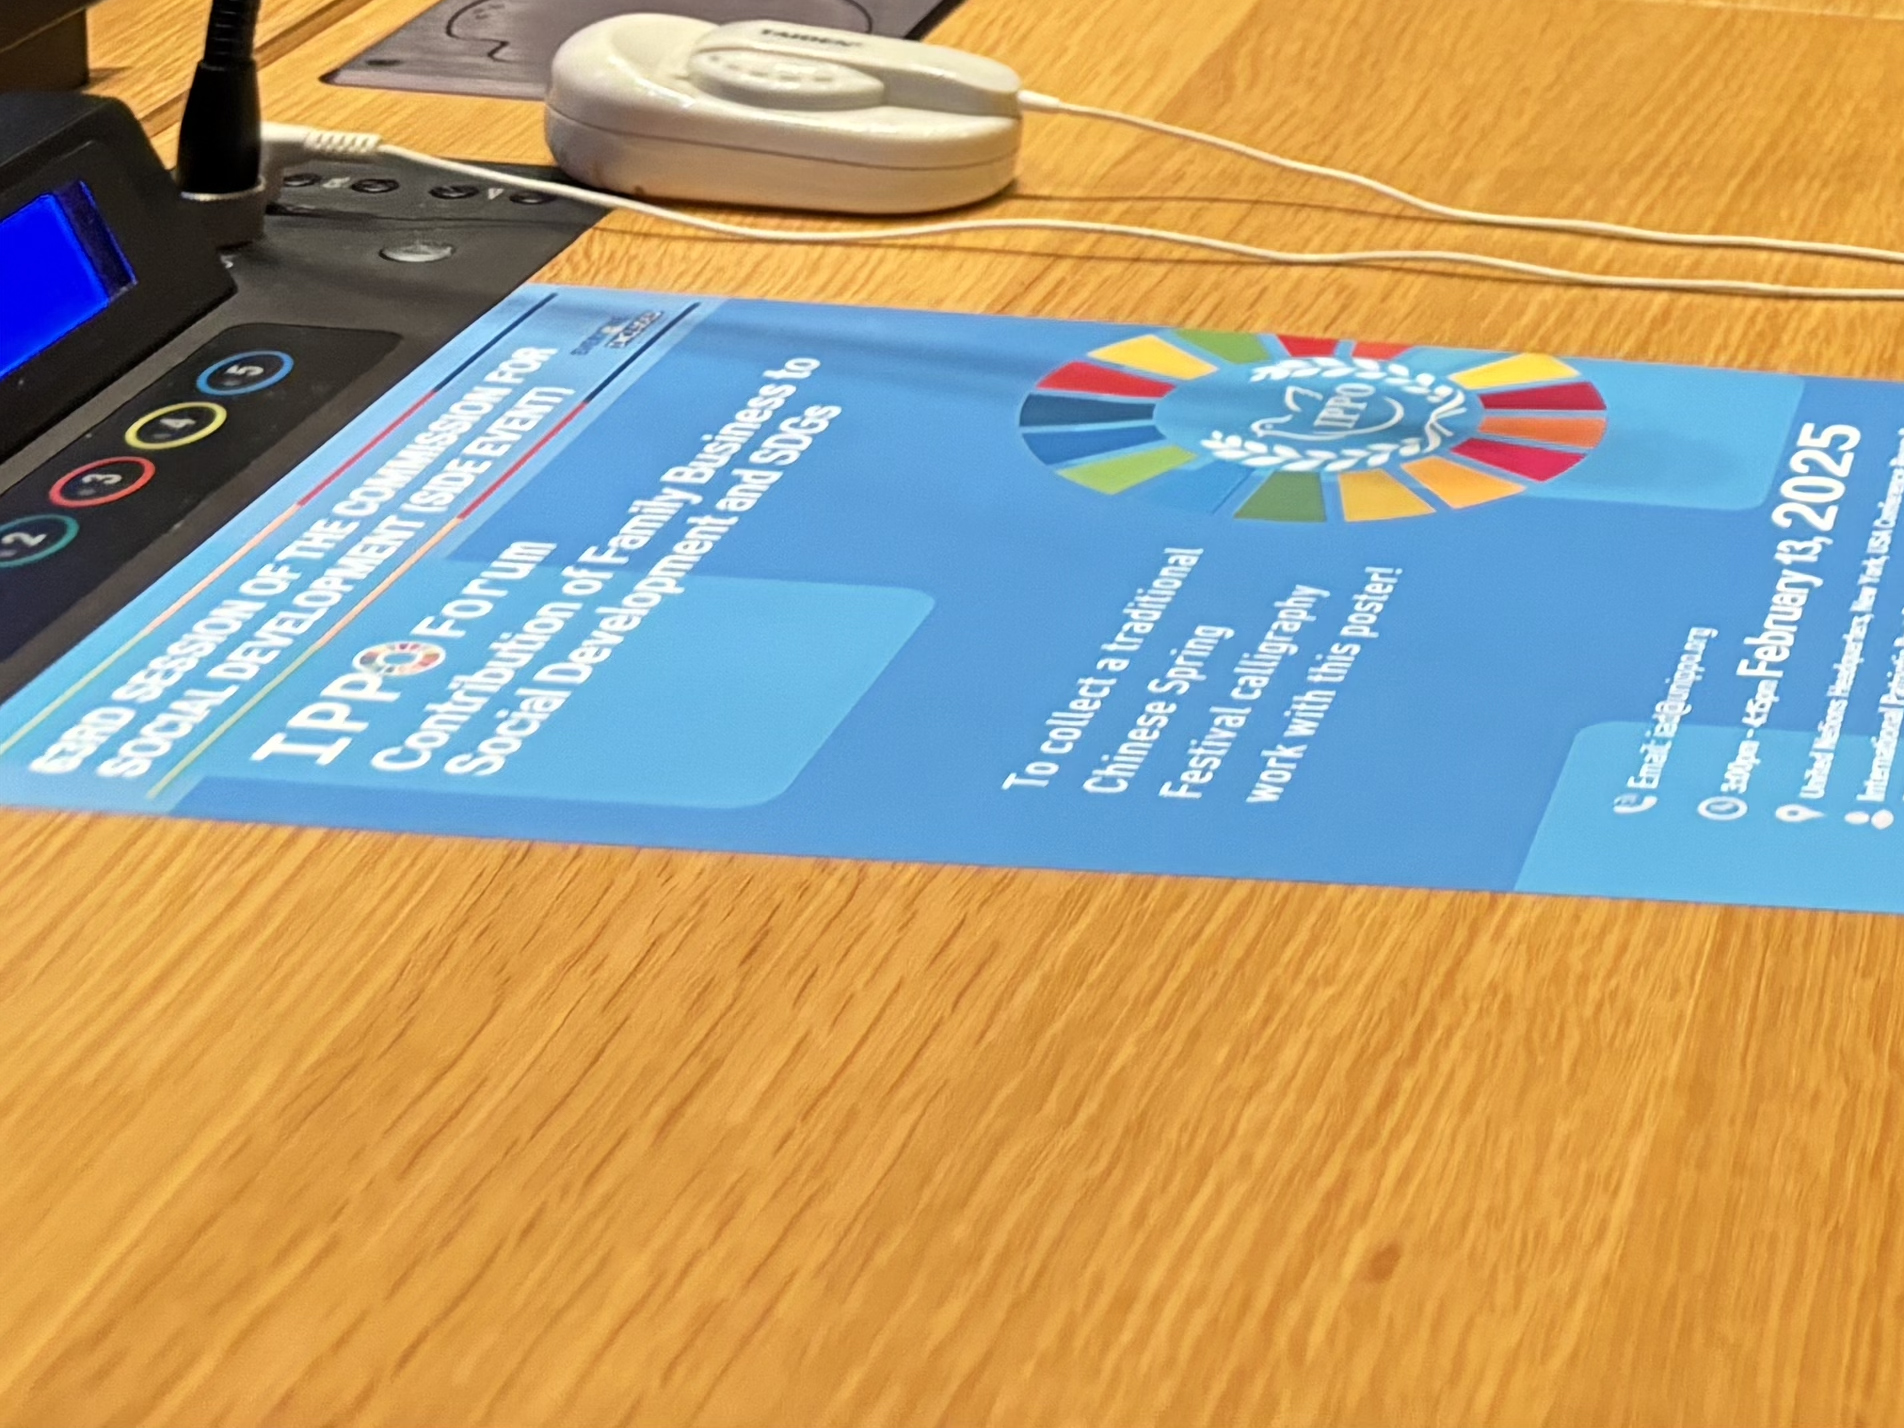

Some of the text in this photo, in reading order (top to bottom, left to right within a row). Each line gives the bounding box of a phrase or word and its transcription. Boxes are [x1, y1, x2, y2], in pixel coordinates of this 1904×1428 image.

[227, 363, 265, 378] 5
[763, 357, 820, 379] to
[1313, 382, 1375, 428] IPPO
[160, 416, 197, 430] 4
[660, 383, 796, 483] Business
[82, 472, 123, 486] 3
[1771, 422, 1860, 531] 2025
[1, 531, 47, 547] 2
[28, 347, 557, 774] 63RD SESSION OF THE COMMISSION FOR
[577, 487, 702, 563] Family
[1774, 536, 1832, 564] 13,
[96, 387, 574, 778] SOCIAL DEVELOPMENT (SIDE EVENT)
[410, 541, 556, 637] Forum
[443, 405, 841, 775] Social Development and SDGs
[561, 565, 613, 595] of
[1736, 569, 1823, 677] February
[370, 602, 582, 771] Contribution
[1002, 547, 1203, 789] To collect a traditional
[1083, 625, 1234, 793] Chinese Spring
[1159, 584, 1329, 798] Festival calligraphy
[1246, 567, 1402, 802] work with this poster!
[1799, 751, 1834, 798] United
[1856, 706, 1904, 801] International
